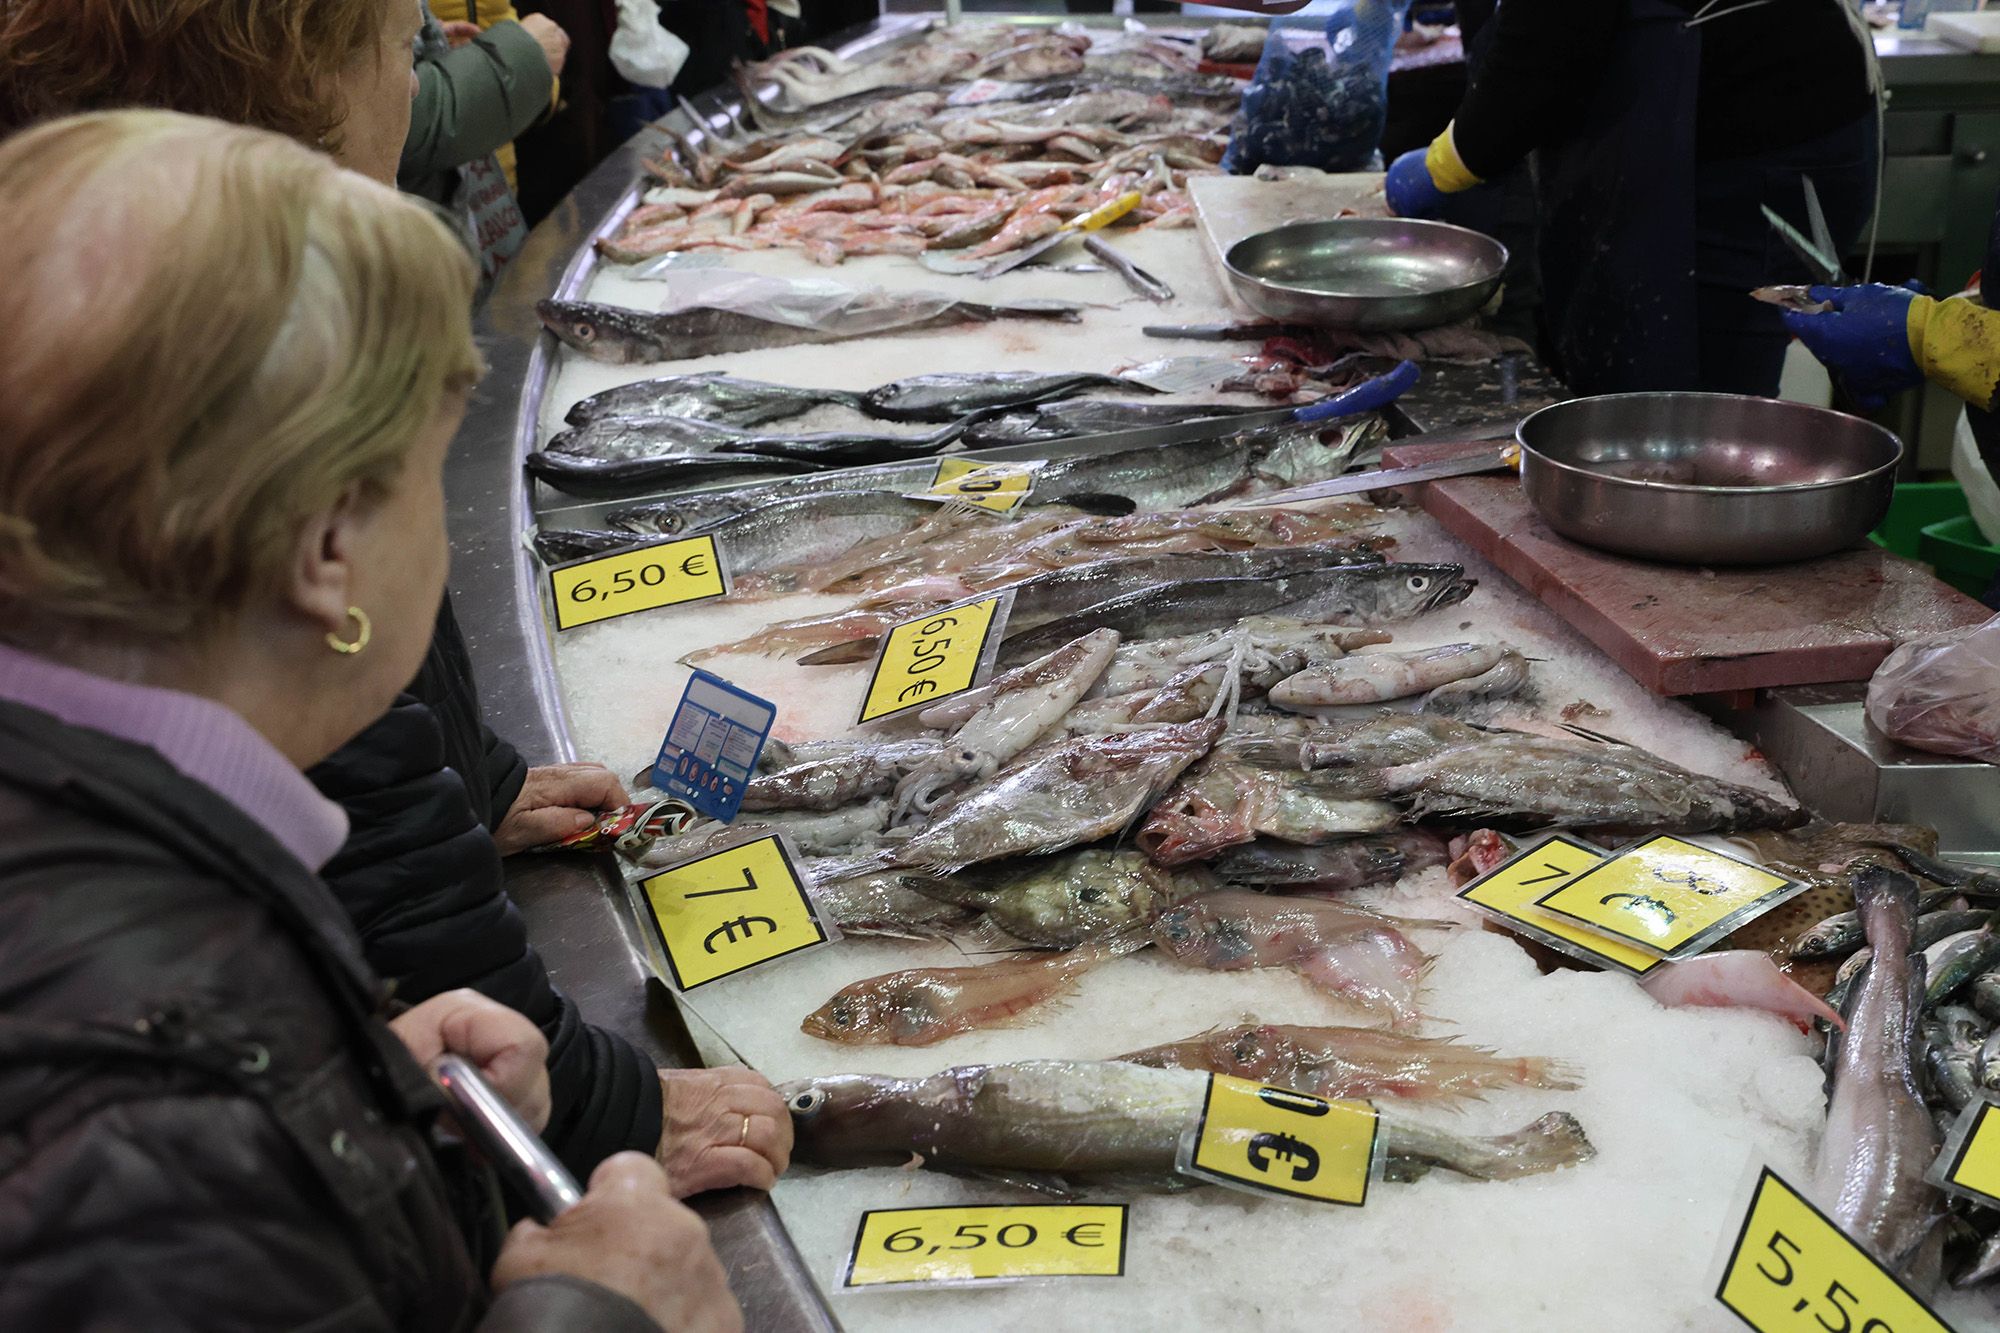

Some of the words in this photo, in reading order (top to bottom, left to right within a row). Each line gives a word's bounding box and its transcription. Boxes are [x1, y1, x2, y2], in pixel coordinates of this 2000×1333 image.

[571, 564, 666, 603] 6,50
[678, 554, 709, 577] €
[907, 617, 958, 675] 6,50
[898, 679, 937, 703] €
[684, 867, 758, 899] 7
[1518, 863, 1571, 886] 7
[703, 915, 777, 955] €
[1246, 1131, 1320, 1182] €
[883, 1223, 1038, 1256] 6,50
[1060, 1223, 1107, 1248] €
